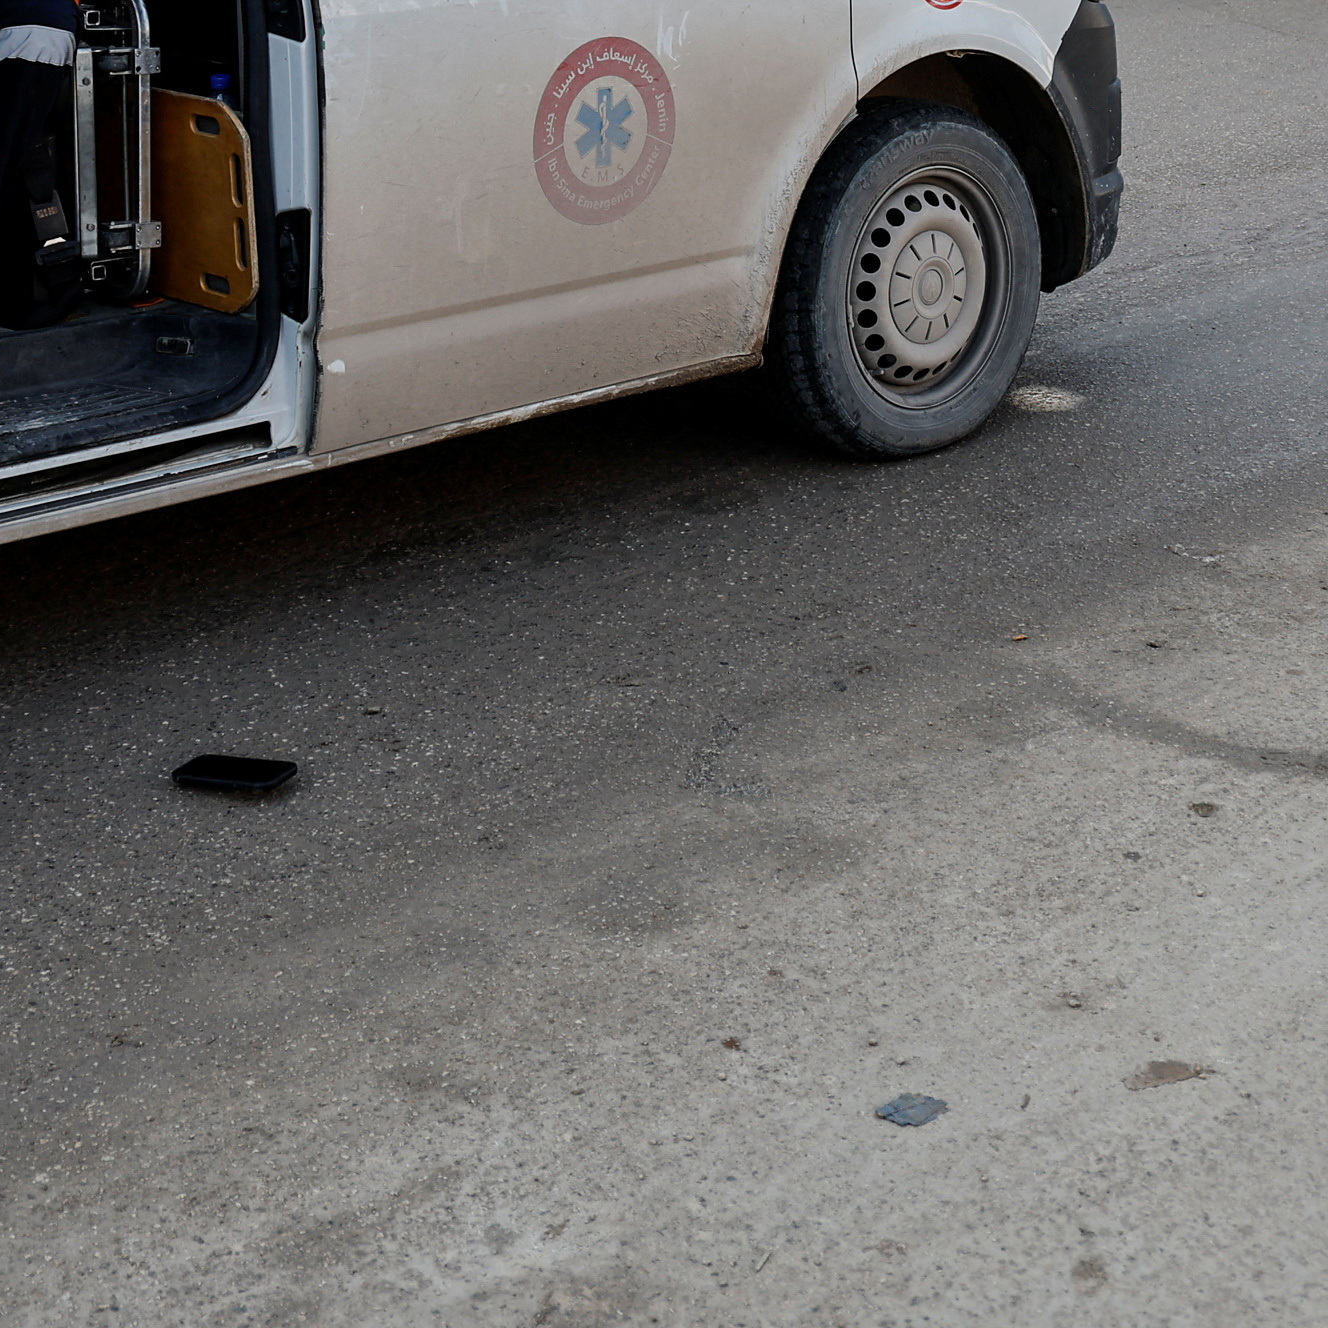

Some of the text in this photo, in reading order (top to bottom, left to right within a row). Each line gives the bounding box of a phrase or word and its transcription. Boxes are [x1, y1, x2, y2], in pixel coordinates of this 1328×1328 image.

[596, 48, 637, 69] إسعاف
[635, 60, 654, 84] مركز
[552, 71, 575, 99] سينا
[655, 92, 669, 133] Jenin
[543, 112, 558, 145] جنين
[547, 145, 660, 210] Ibn Sina Emergency Center
